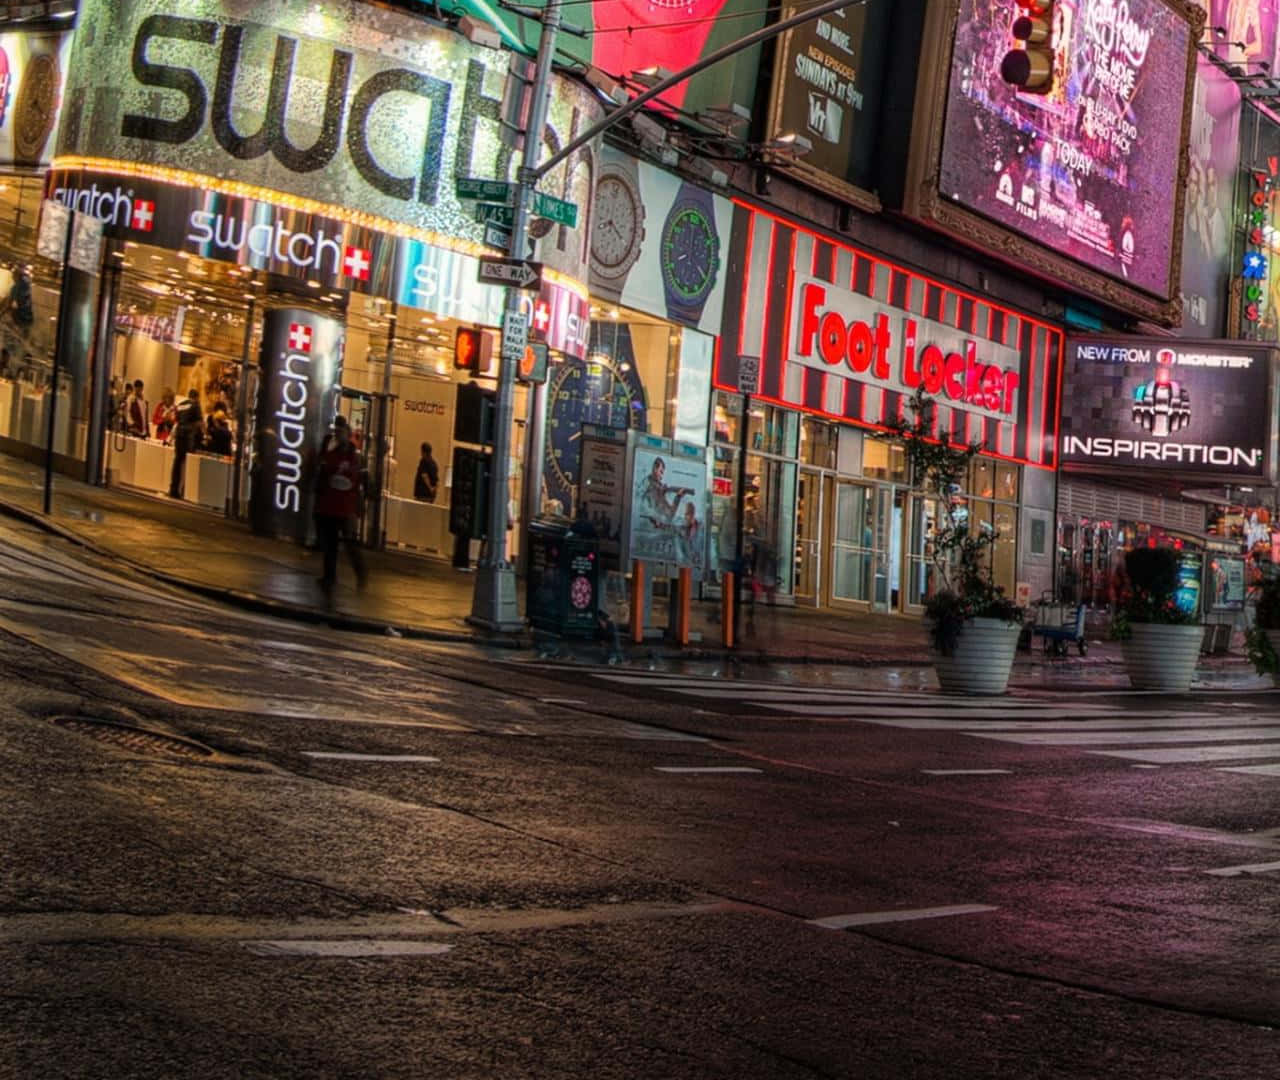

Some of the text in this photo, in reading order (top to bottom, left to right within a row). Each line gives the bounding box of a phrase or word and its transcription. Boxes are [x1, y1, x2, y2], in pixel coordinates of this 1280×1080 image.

[1054, 138, 1093, 176] TODAY
[187, 210, 342, 272] swatch
[510, 266, 531, 281] WAY
[799, 283, 1020, 416] Foot Locker
[1077, 346, 1110, 361] NEW
[1111, 348, 1151, 363] FROM
[275, 352, 312, 513] swatch
[1064, 436, 1257, 467] INSPIRATION
